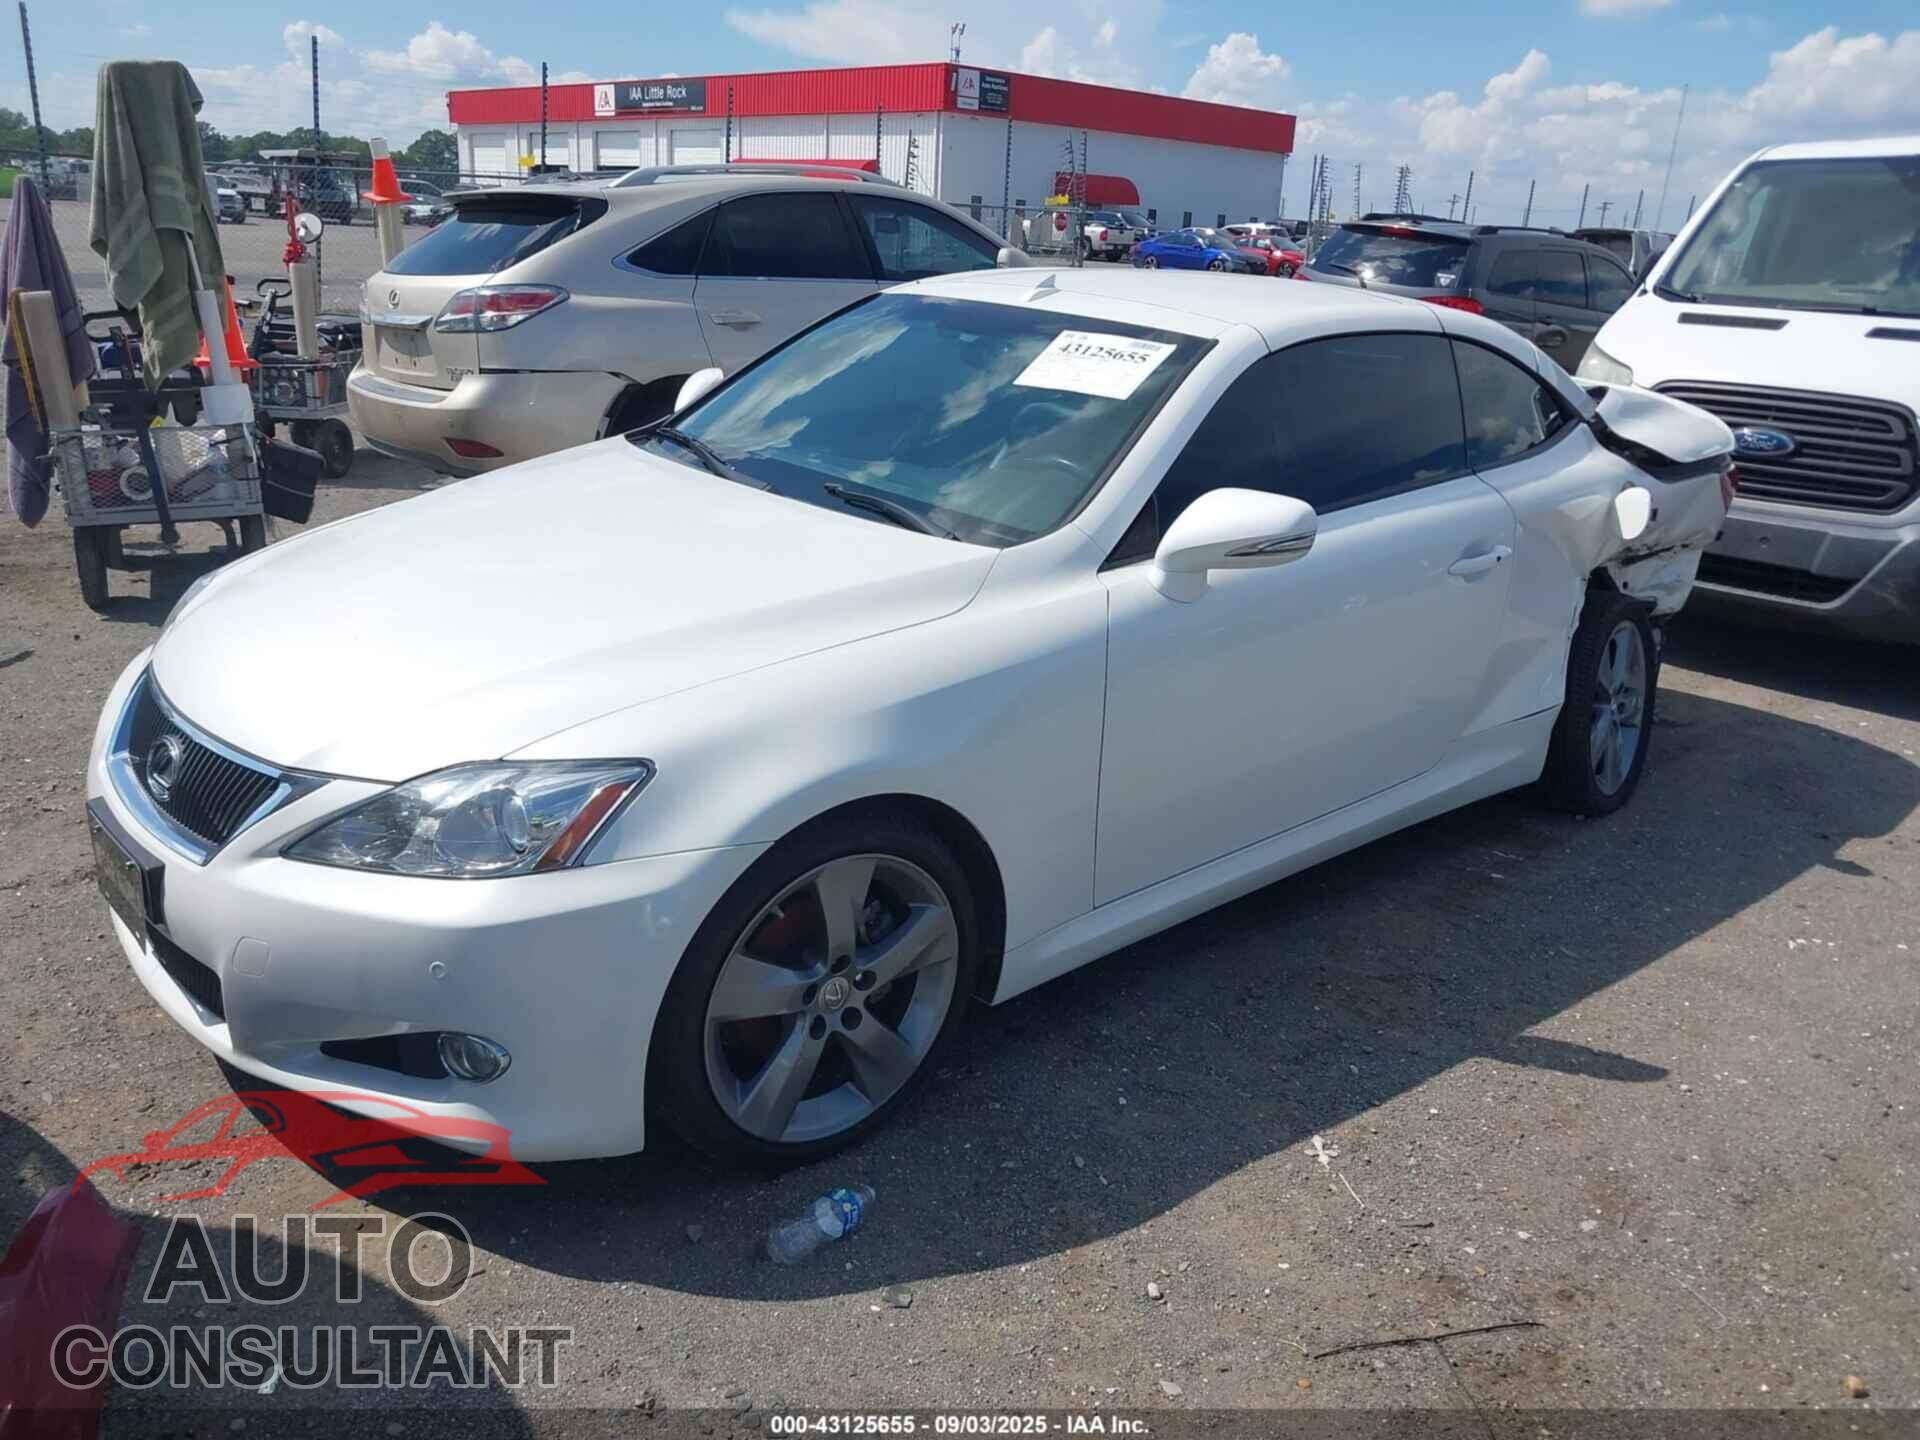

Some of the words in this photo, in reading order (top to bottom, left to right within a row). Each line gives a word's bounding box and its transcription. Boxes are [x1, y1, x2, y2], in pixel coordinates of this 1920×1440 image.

[629, 86, 642, 101] IAA
[644, 84, 664, 100] Little
[667, 83, 687, 99] Rock
[1058, 343, 1151, 364] 43125655
[1741, 432, 1777, 450] Ford
